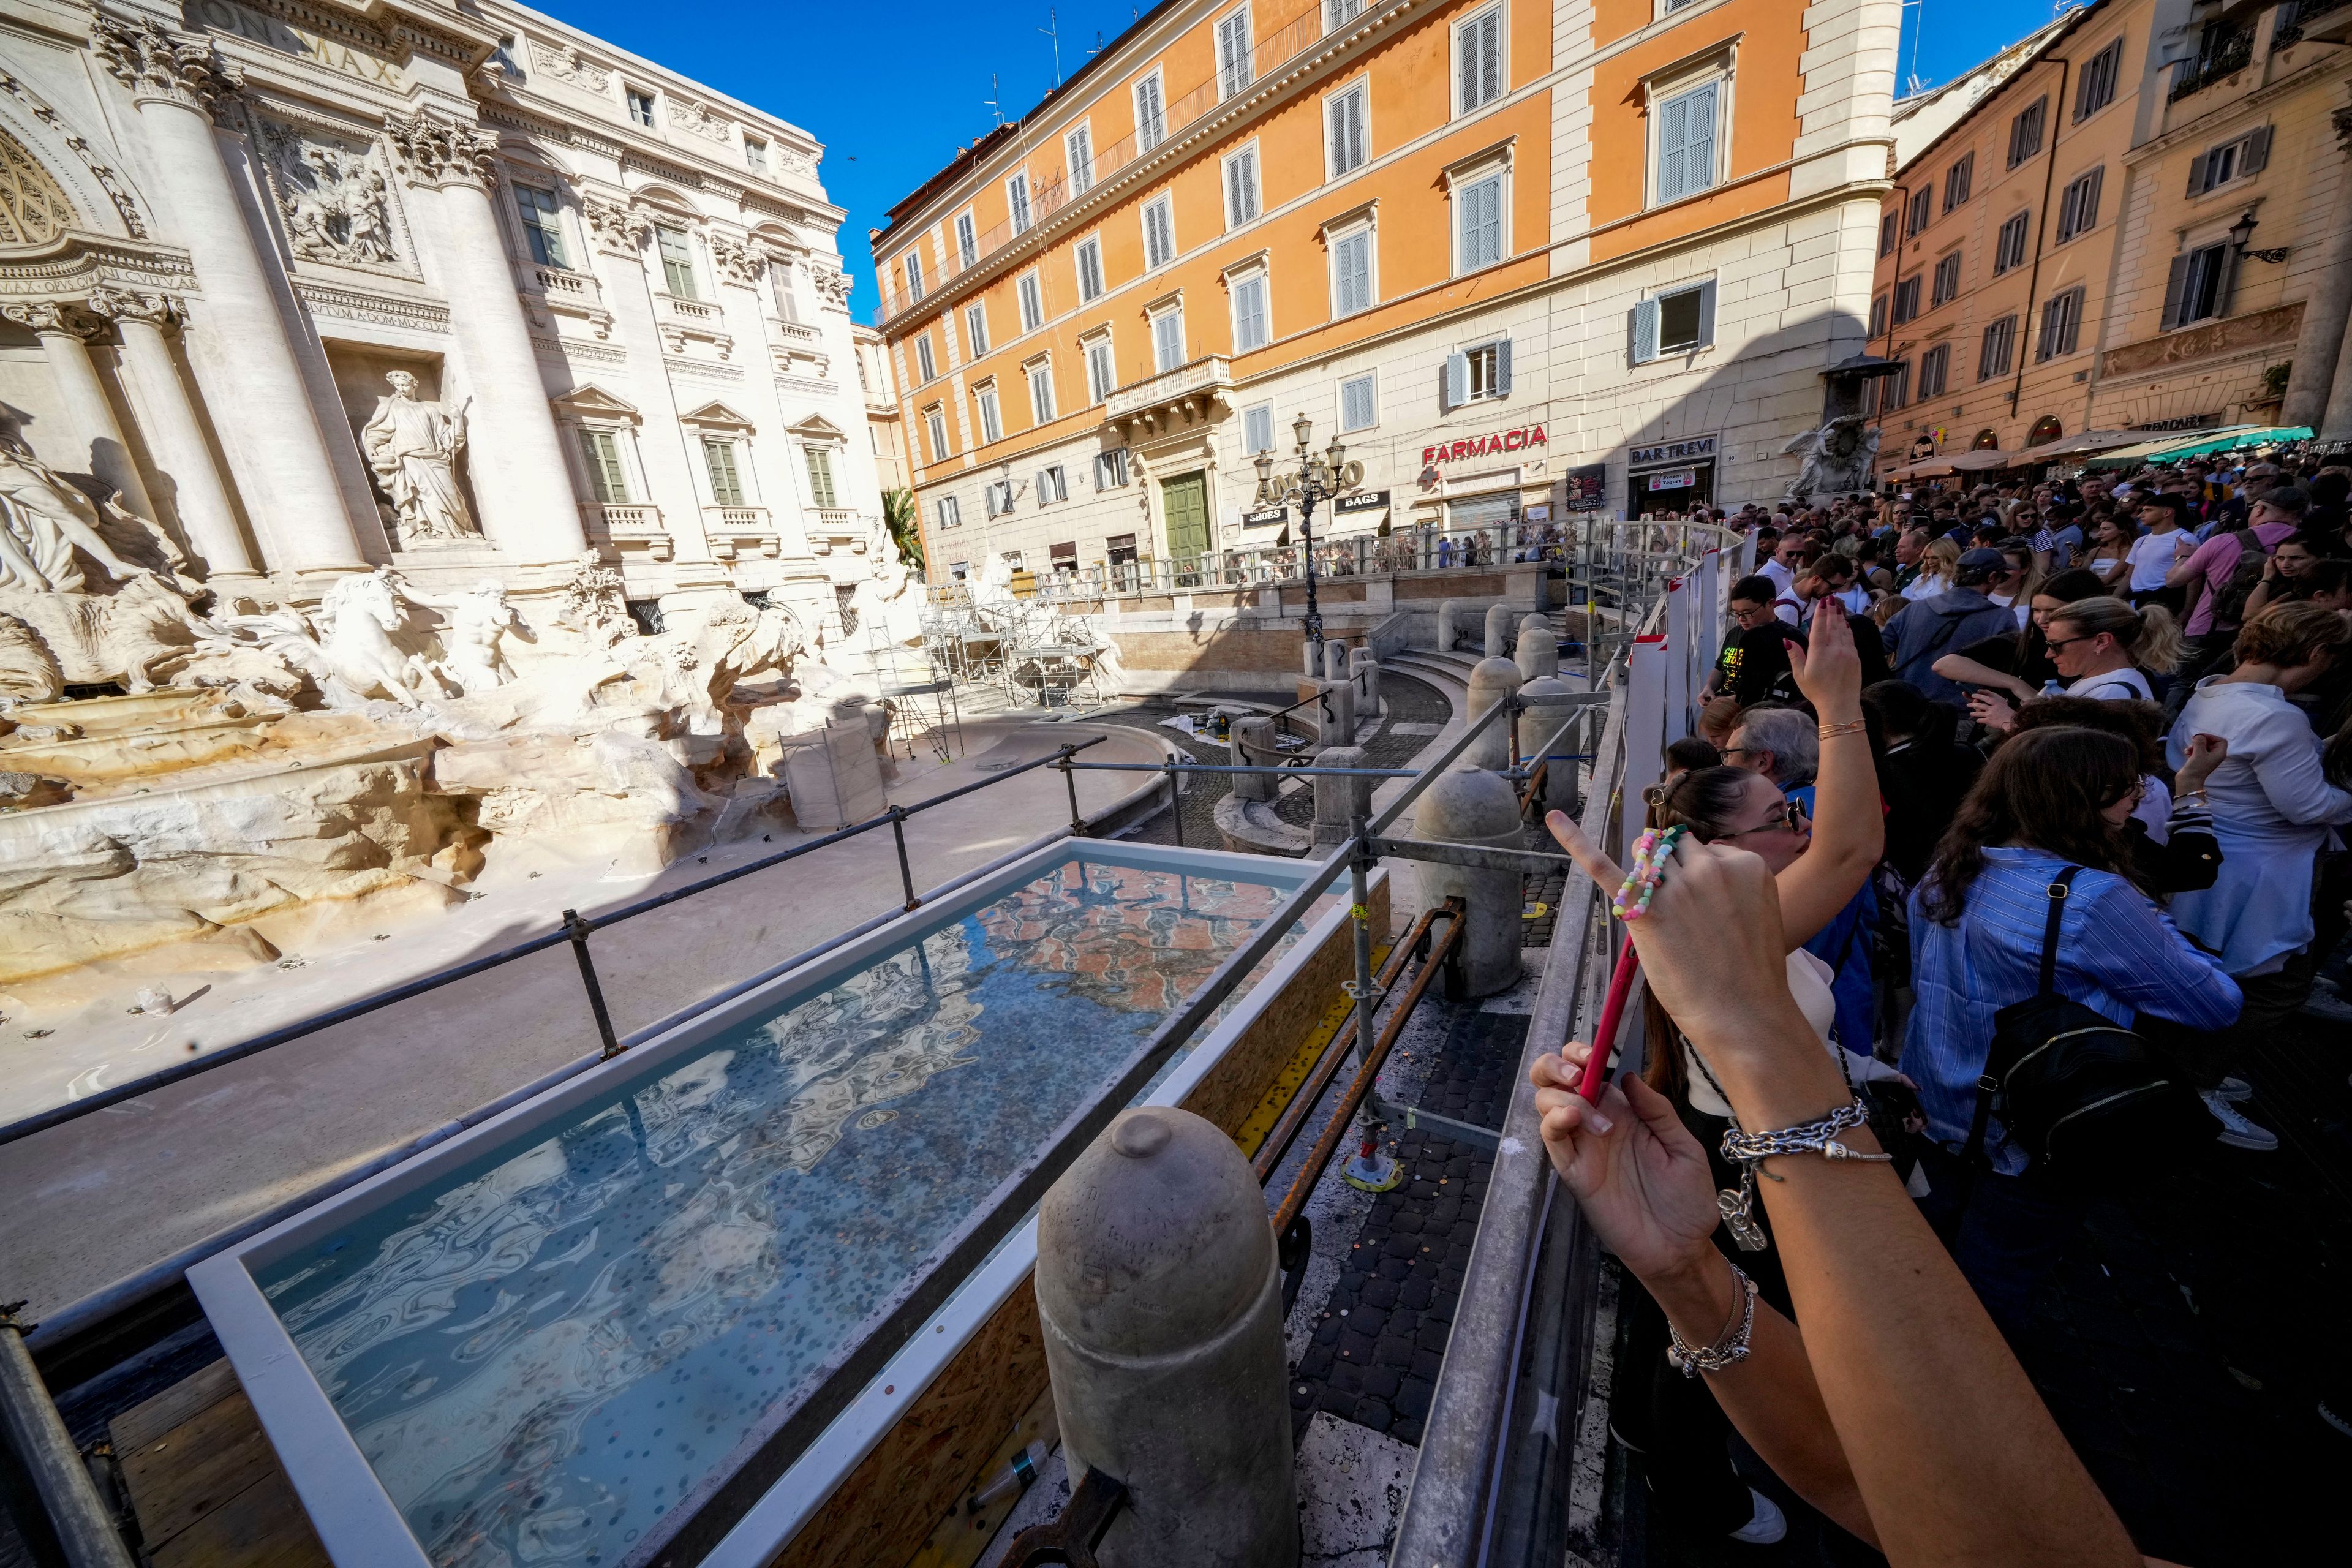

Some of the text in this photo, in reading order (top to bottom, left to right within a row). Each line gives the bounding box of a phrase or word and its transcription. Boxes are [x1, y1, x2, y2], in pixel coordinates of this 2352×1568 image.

[296, 29, 399, 88] MAX
[45, 278, 74, 292] OPVS
[1424, 425, 1547, 464] FARMACIA
[1632, 438, 1714, 463] BAR TREVI
[1253, 460, 1366, 507] ANLO
[1345, 494, 1378, 507] BAGS
[1250, 510, 1281, 522] SHOES
